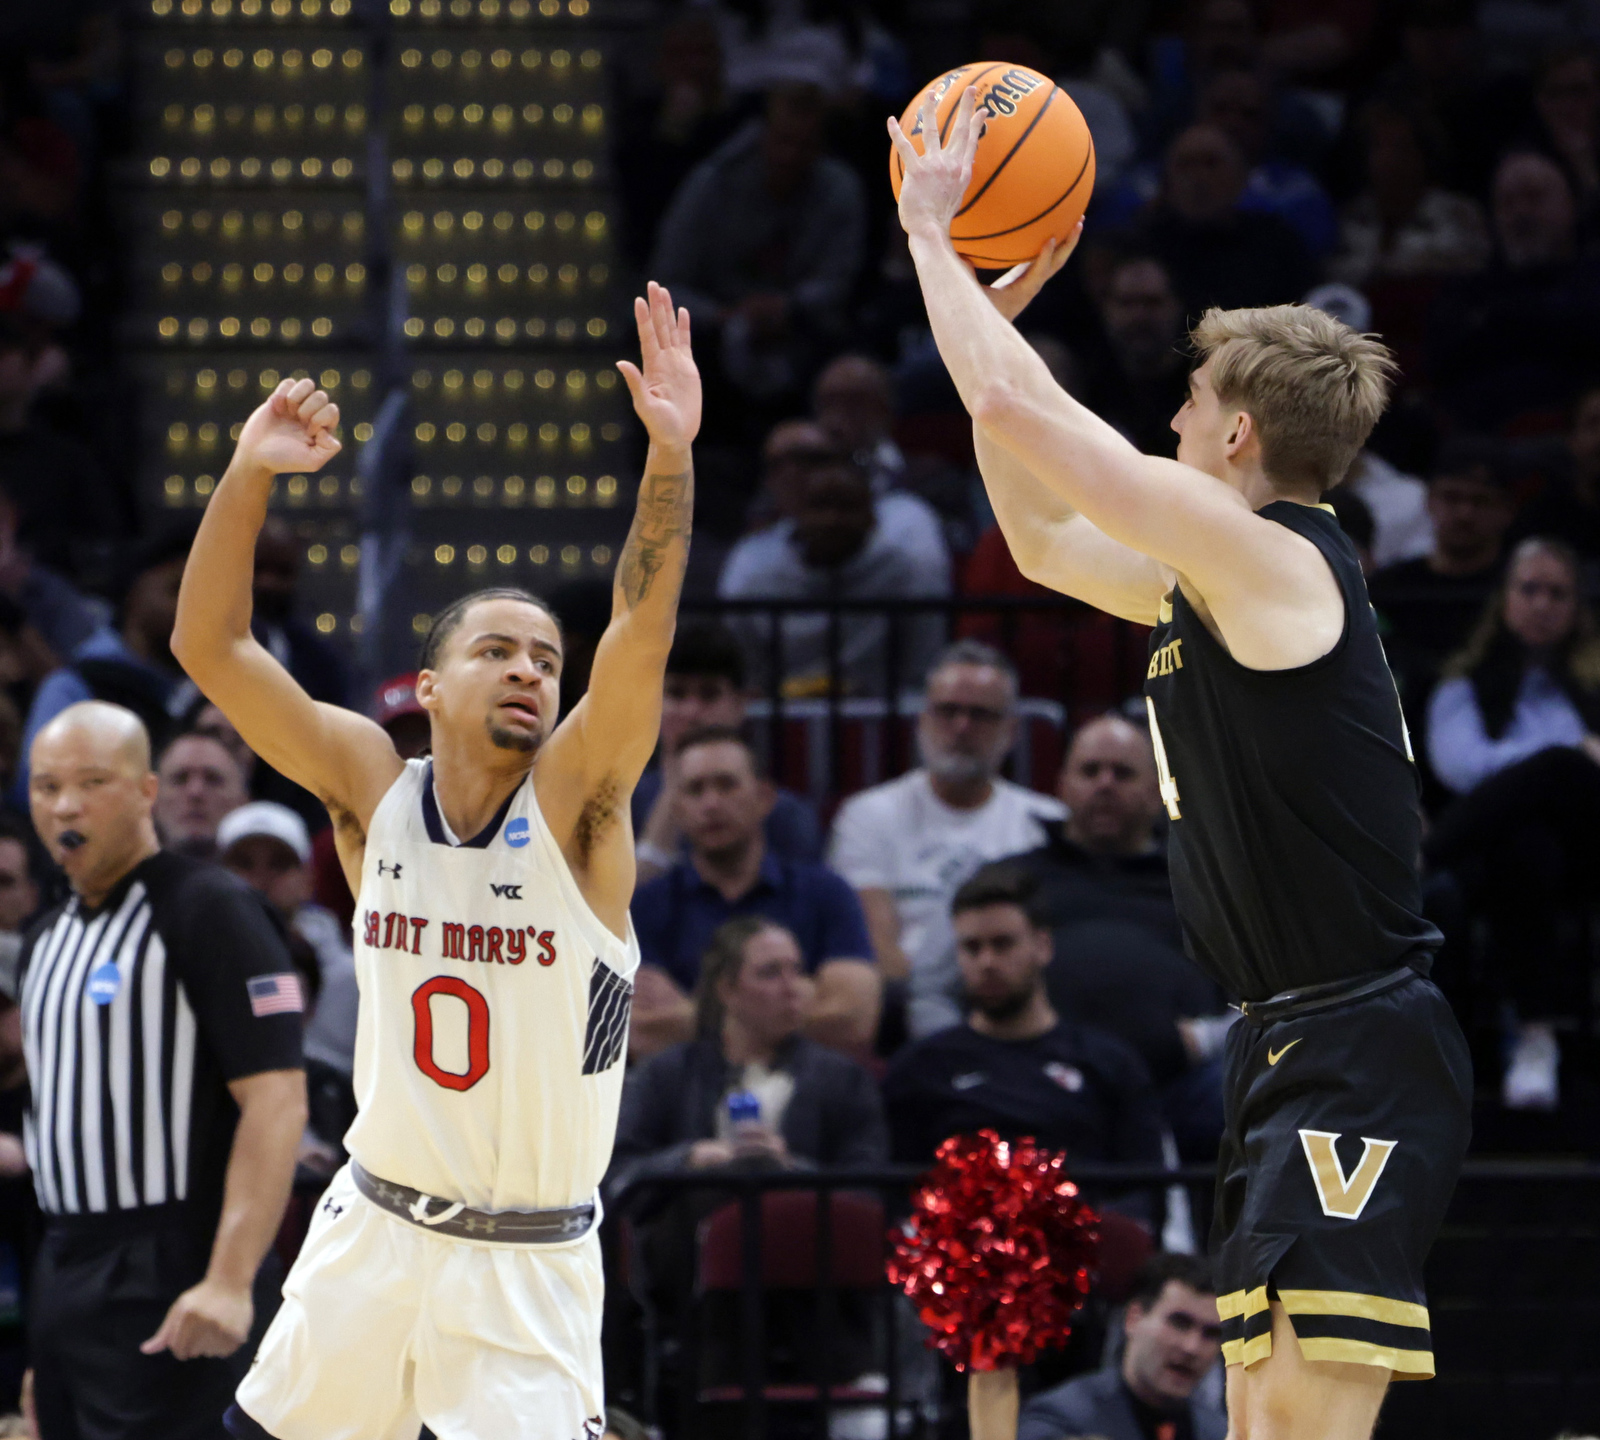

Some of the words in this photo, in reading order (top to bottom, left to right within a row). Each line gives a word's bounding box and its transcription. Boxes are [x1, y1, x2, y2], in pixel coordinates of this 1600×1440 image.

[489, 883, 523, 900] WCC
[364, 910, 429, 956] SAINT
[442, 921, 556, 967] MARY'S
[411, 975, 490, 1092] 0
[1298, 1129, 1399, 1221] V
